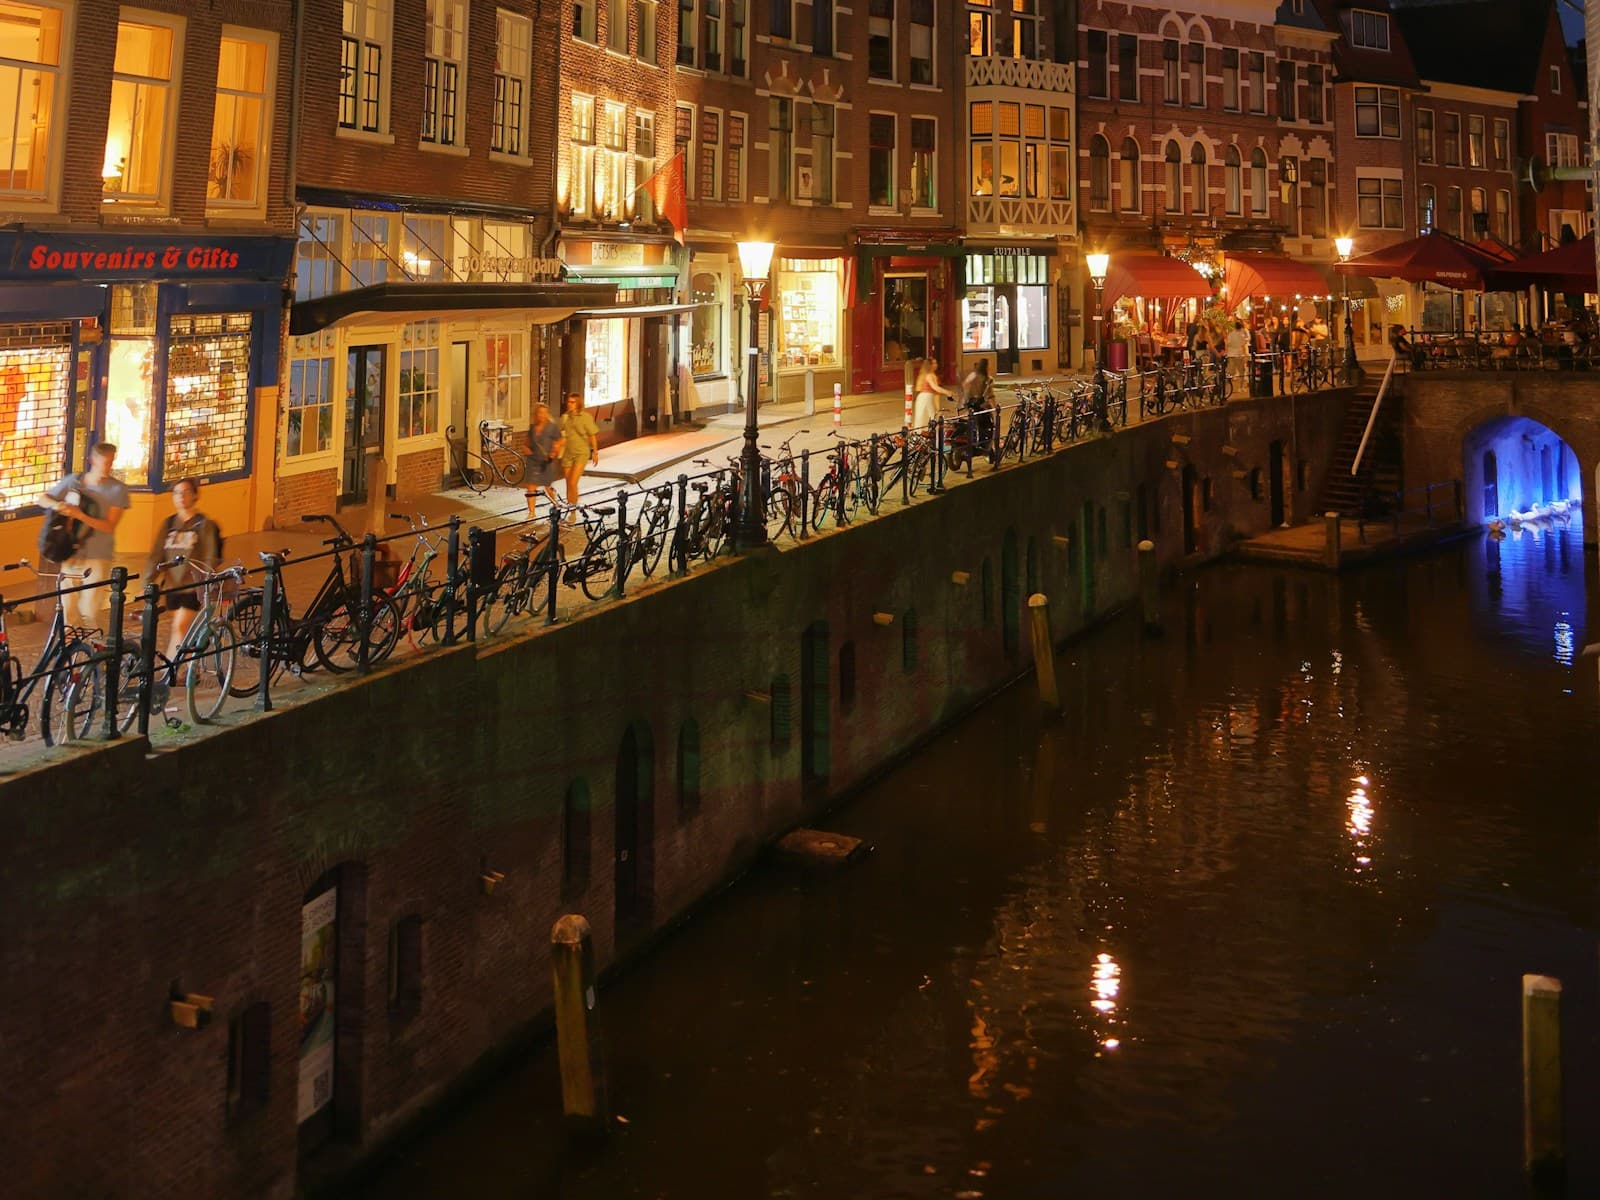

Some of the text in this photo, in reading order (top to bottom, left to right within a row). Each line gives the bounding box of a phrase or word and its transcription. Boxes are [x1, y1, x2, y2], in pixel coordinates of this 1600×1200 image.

[29, 245, 239, 270] Souvenirs & Gifts
[459, 250, 561, 278] coffeecompany
[993, 247, 1031, 256] SUITABLE
